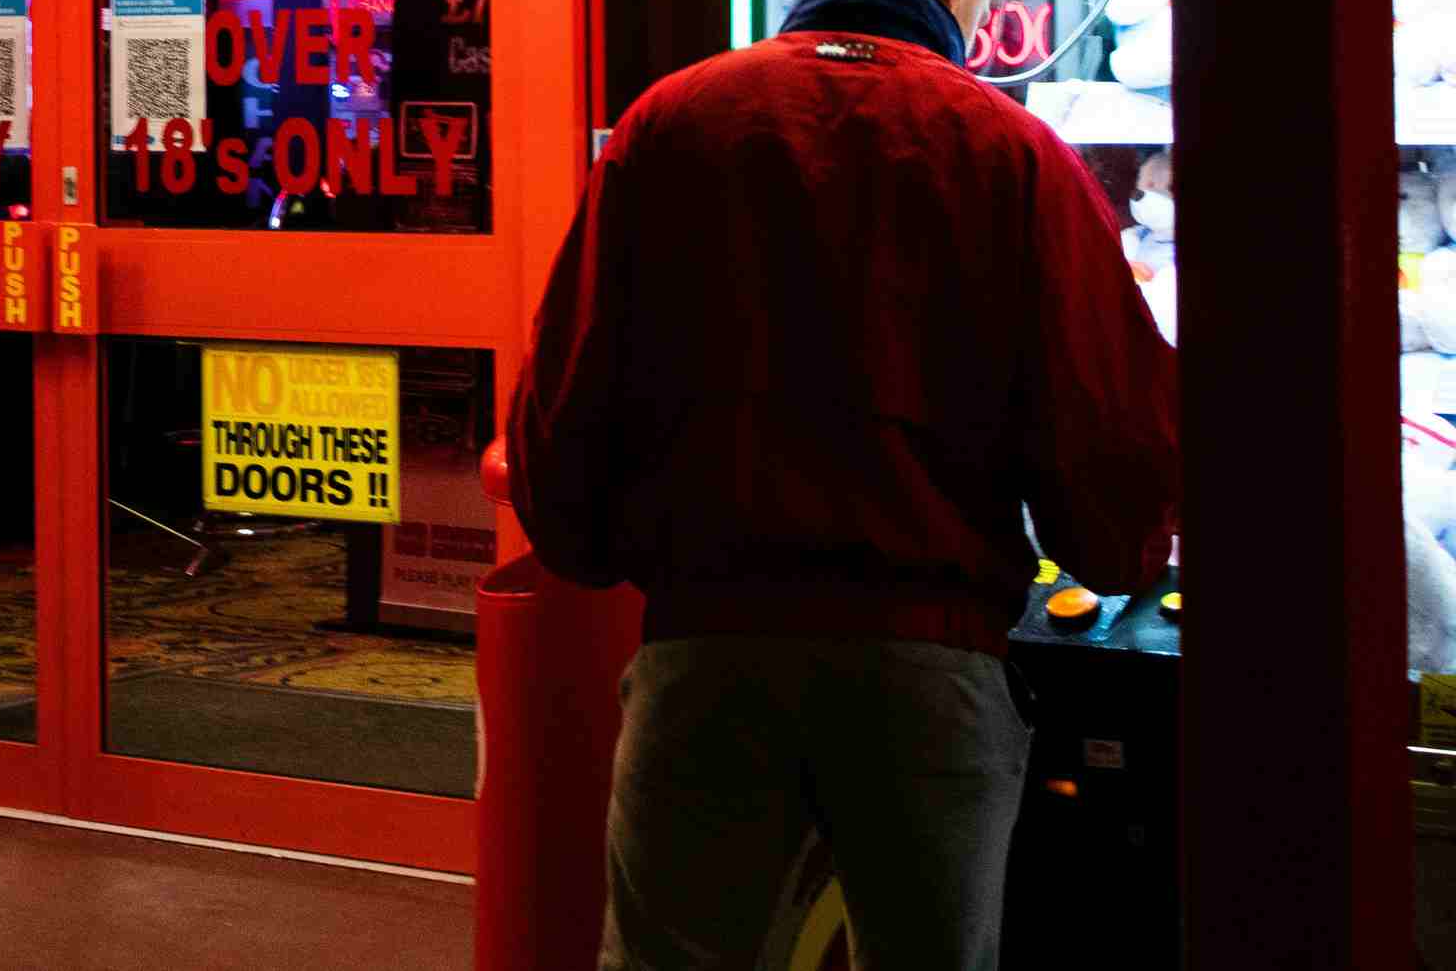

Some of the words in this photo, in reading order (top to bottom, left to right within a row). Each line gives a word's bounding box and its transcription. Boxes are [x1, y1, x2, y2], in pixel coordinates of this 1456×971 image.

[207, 9, 377, 86] OVER
[124, 116, 250, 195] 18's
[272, 116, 470, 196] ONLY
[2, 221, 28, 325] PUSH
[57, 226, 83, 328] PUSH
[210, 354, 284, 413] NO
[212, 420, 313, 460] THROUGH
[319, 425, 388, 465] THESE
[215, 462, 353, 507] DOORS
